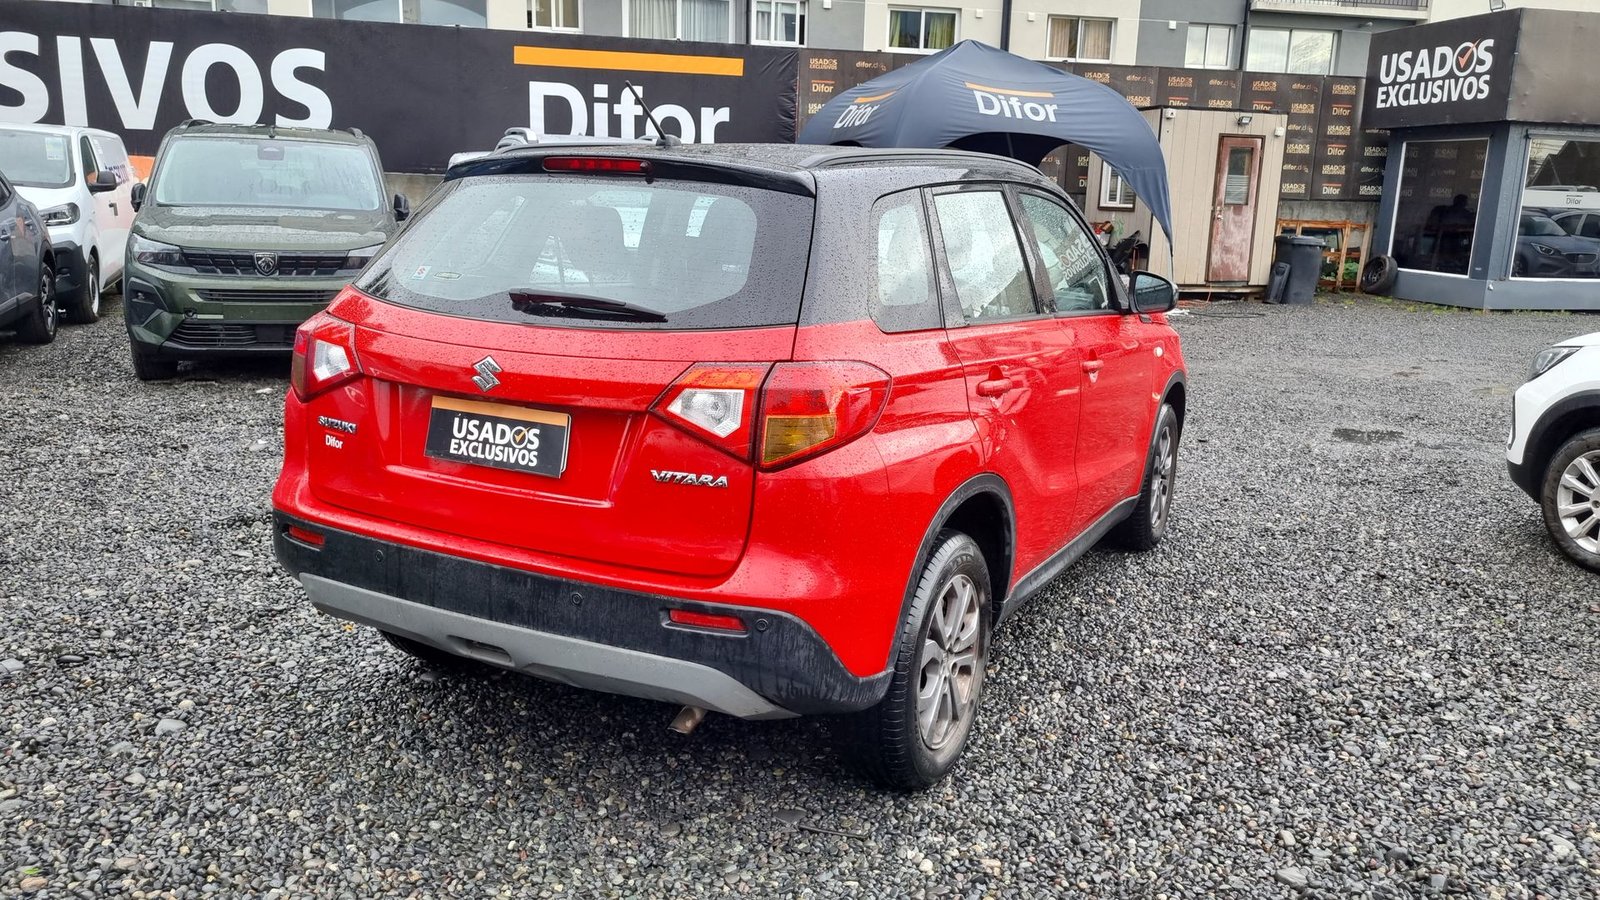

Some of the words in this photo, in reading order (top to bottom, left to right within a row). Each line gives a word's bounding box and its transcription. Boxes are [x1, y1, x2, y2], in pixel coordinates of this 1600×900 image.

[1380, 39, 1494, 85] USADOS
[812, 84, 834, 93] Difor
[1376, 75, 1490, 108] EXCLUSIVOS
[973, 90, 1058, 123] Difor
[1126, 95, 1151, 103] USADOS
[529, 80, 731, 145] Difor
[833, 104, 880, 129] Difor
[1332, 107, 1351, 116] Difor
[1327, 147, 1345, 156] Difor
[1322, 186, 1340, 195] Difor
[318, 415, 356, 434] SUZUKI
[452, 417, 540, 450] USADOS
[325, 434, 343, 449] Difor
[449, 438, 538, 467] EXCLUSIVOS
[650, 469, 728, 488] VITARA
